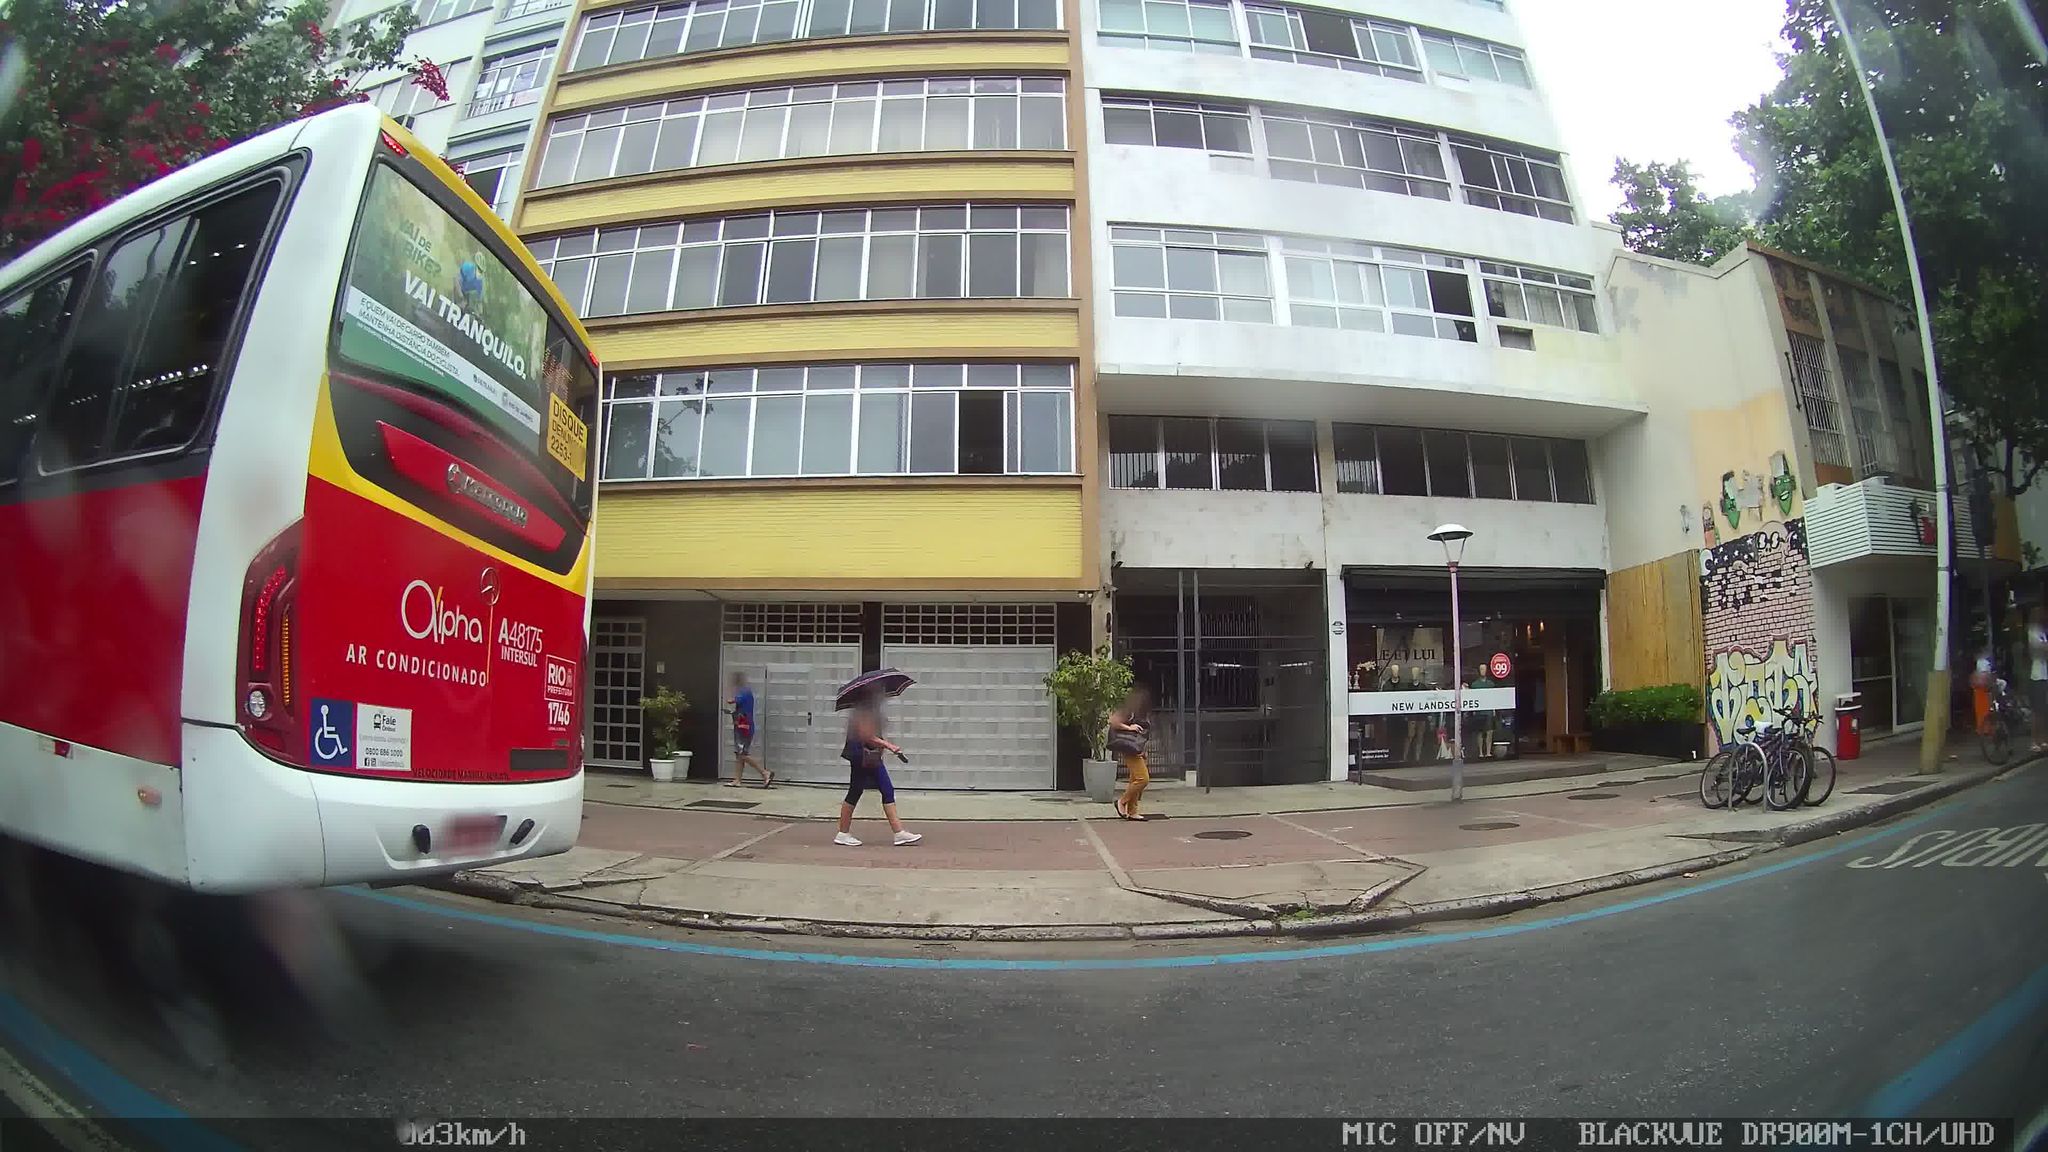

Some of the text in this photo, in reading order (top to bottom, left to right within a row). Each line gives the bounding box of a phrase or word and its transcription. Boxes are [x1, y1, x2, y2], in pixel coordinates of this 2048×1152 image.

[404, 270, 437, 309] VAI
[553, 400, 584, 444] DISQUE
[498, 617, 543, 653] A48175
[346, 643, 486, 687] AR CONDICIONADO
[501, 646, 538, 667] INTERSUL
[1414, 649, 1436, 660] LUI
[548, 662, 566, 686] RIO
[548, 702, 570, 726] 1746
[1391, 699, 1480, 711] NEW LANDSCPES
[382, 714, 397, 726] Fale
